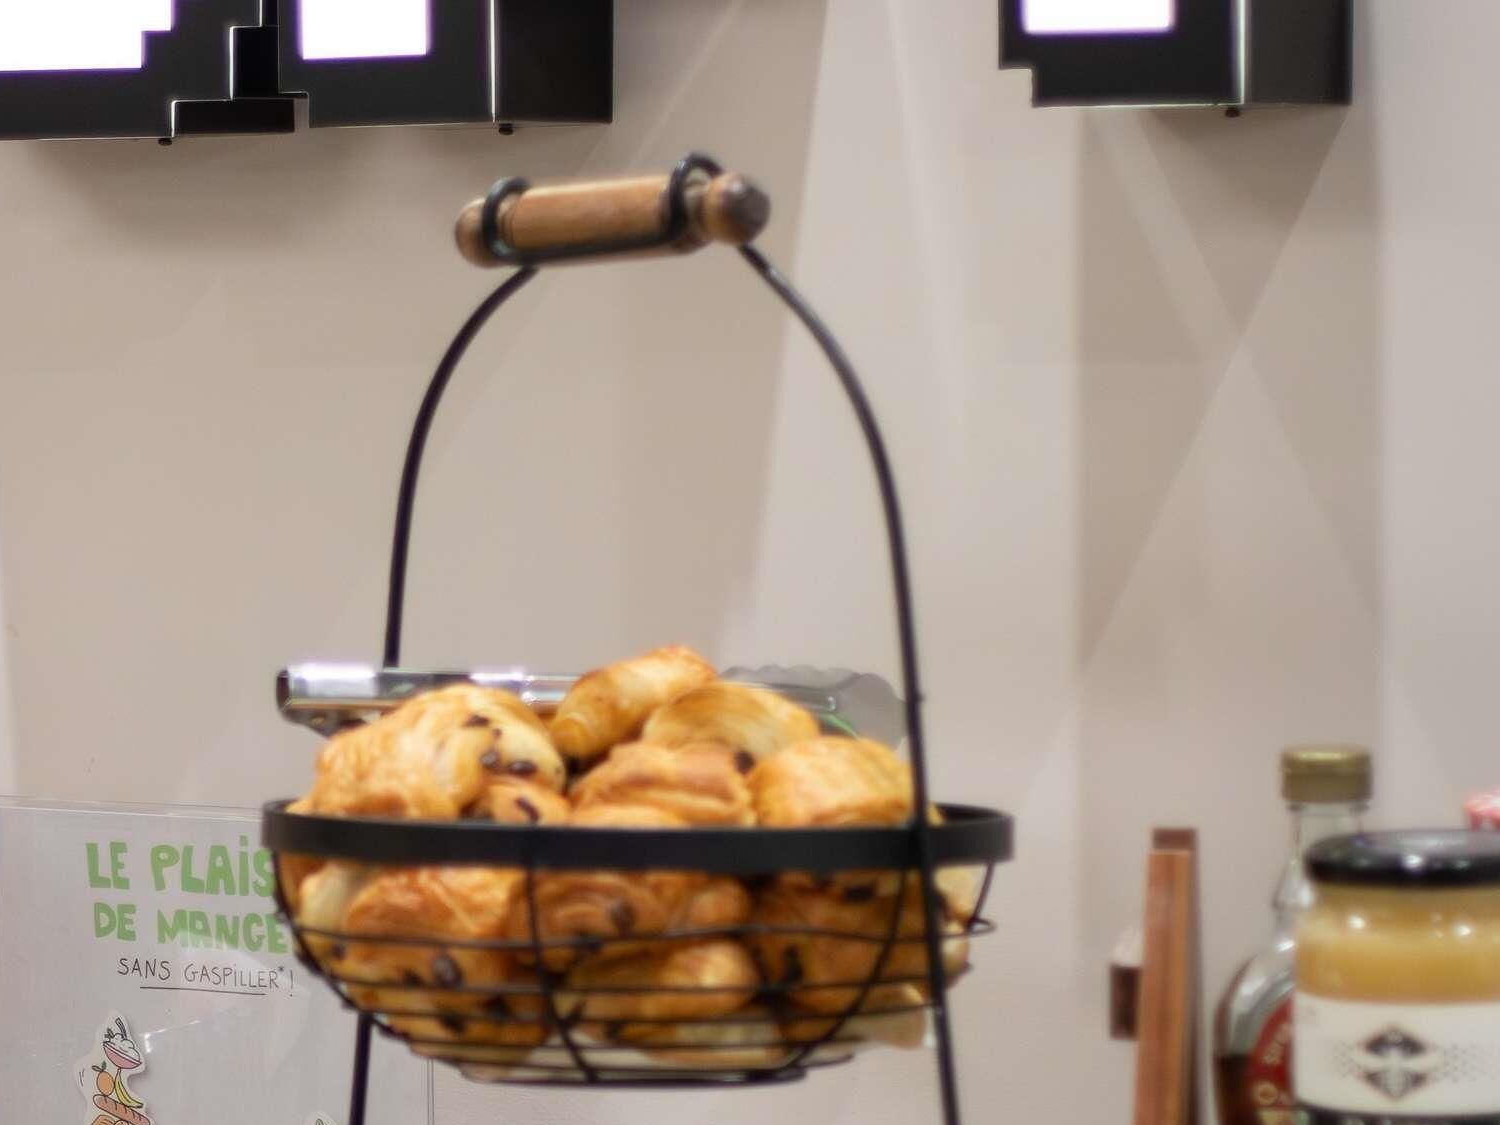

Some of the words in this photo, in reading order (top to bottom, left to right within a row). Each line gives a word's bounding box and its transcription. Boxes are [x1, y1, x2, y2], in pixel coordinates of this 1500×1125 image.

[86, 841, 130, 890] LE
[94, 902, 137, 942] DE
[157, 909, 289, 954] MANGE
[117, 957, 171, 981] SANS
